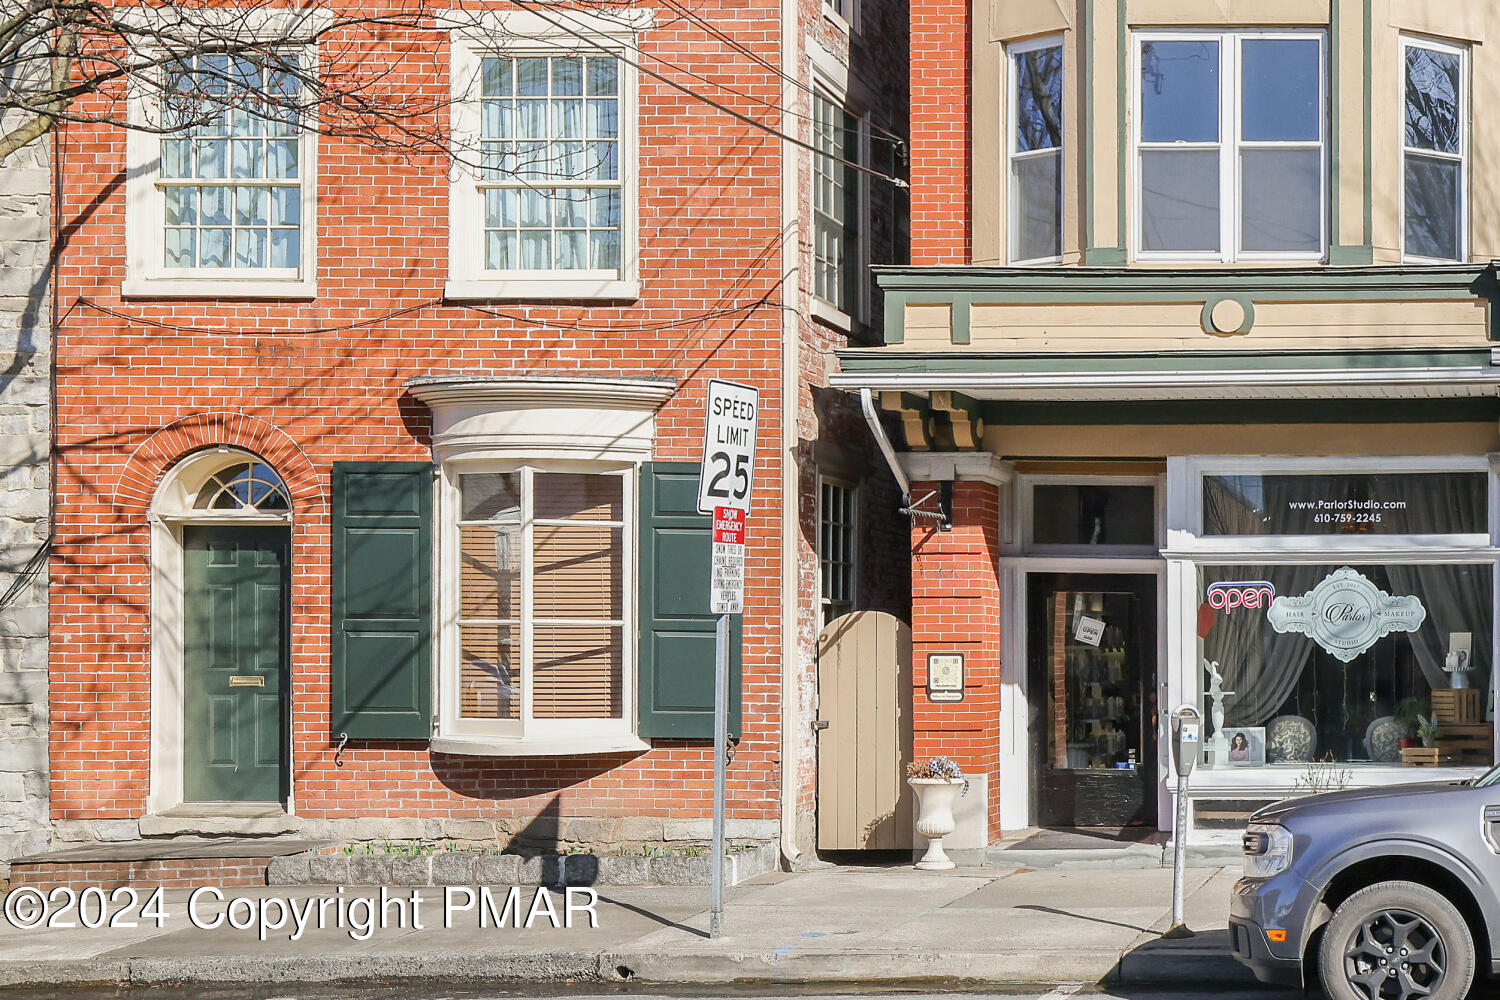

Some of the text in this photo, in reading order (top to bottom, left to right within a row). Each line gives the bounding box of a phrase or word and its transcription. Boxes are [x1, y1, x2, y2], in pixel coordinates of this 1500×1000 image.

[713, 396, 754, 421] SPEED
[717, 424, 749, 447] LIMIT
[707, 451, 749, 500] 25
[1289, 500, 1406, 510] www.ParlorStudio.com
[722, 508, 738, 520] SNOW
[1314, 513, 1382, 523] 610-759-2245
[715, 519, 743, 531] EMERGENCY
[721, 532, 737, 543] ROUTE
[1209, 587, 1273, 614] open
[1324, 602, 1369, 626] Parlor
